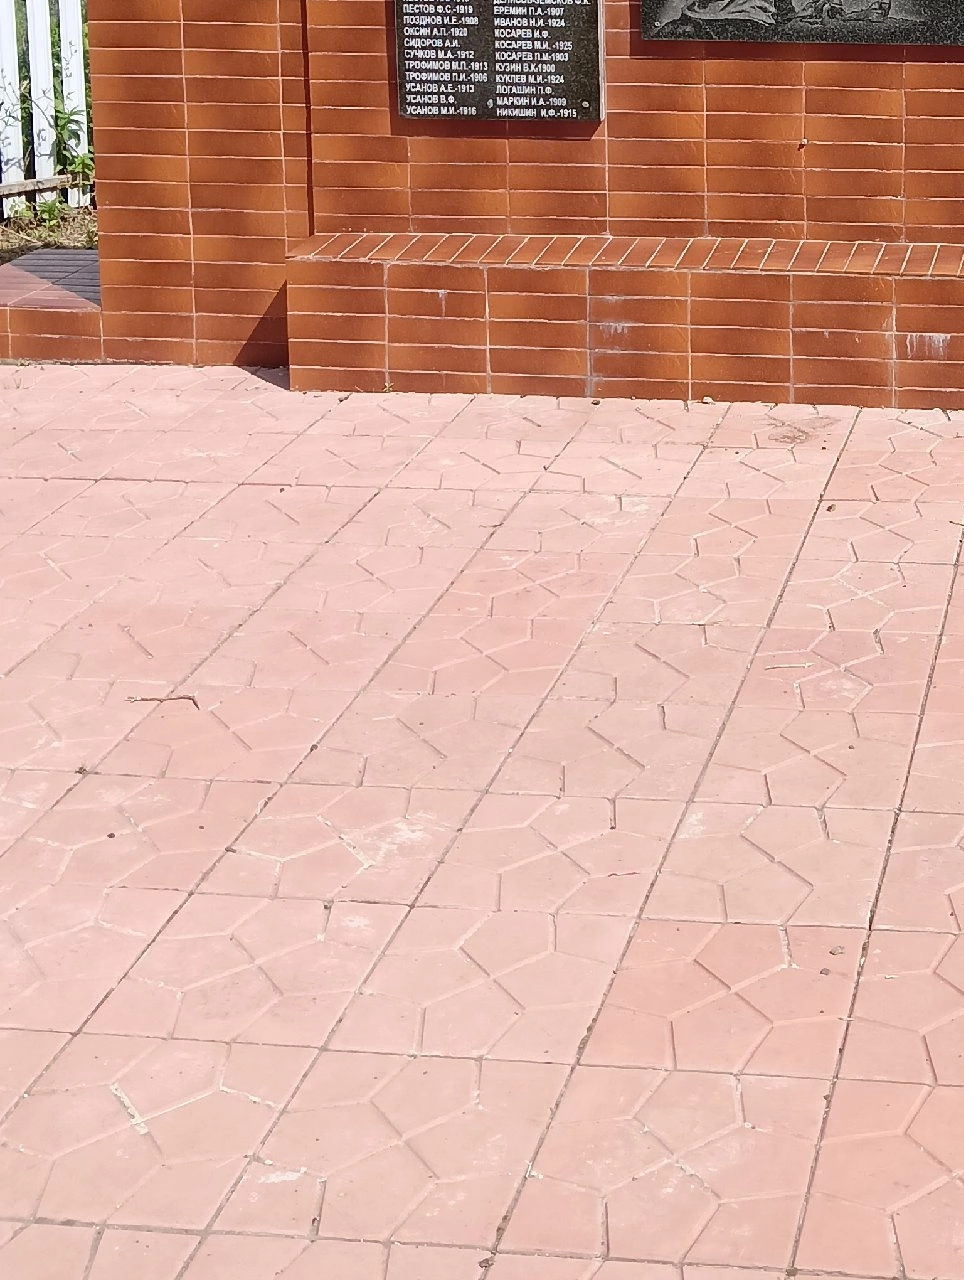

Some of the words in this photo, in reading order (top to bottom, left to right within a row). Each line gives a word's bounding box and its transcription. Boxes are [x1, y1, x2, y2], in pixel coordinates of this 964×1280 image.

[403, 4, 435, 13] ПЕСТОВ
[494, 6, 527, 14] ЕРЕМИН
[404, 16, 442, 25] ПОЗДНОВ
[494, 18, 528, 26] ИВАНОВ
[404, 27, 430, 35] ОКСИН
[495, 29, 532, 37] КОСАРЕВ
[404, 38, 443, 48] СИДОРОВ
[445, 39, 460, 47] А.И.
[495, 41, 532, 49] КОСАРЕВ
[405, 50, 436, 58] СУЧКОВ
[496, 52, 533, 60] КОСАРЕВ
[405, 61, 450, 69] ТРОФИМОВ
[496, 63, 521, 71] КУЗИН
[405, 72, 450, 81] ТРОФИМОВ
[496, 75, 526, 83] КУКЛЕВ
[406, 83, 438, 92] УСАНОВ
[496, 85, 535, 94] ЛОГАШИН
[406, 95, 438, 103] УСАНОВ
[440, 95, 457, 104] В.Ф.
[497, 97, 529, 105] МАРКИН
[406, 105, 438, 114] УСАНОВ
[497, 108, 536, 116] НИКИШИН
